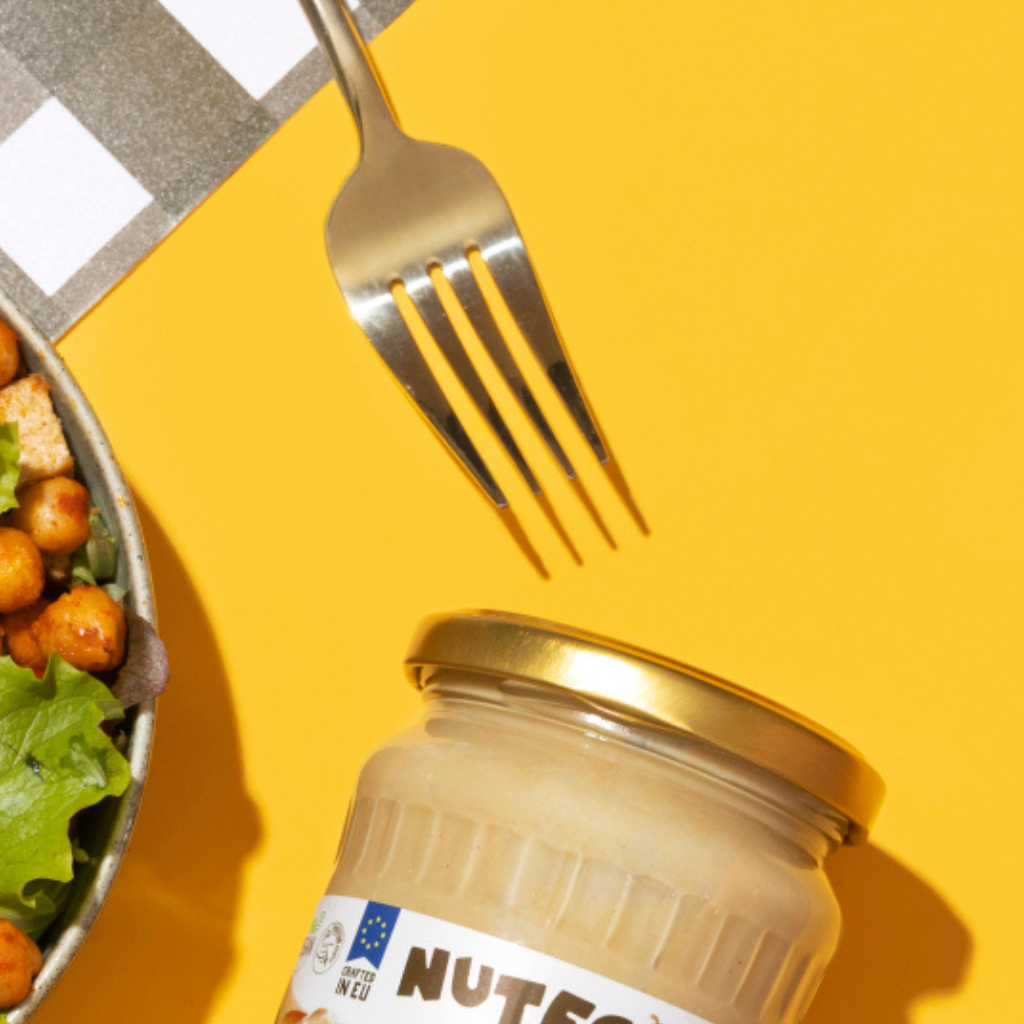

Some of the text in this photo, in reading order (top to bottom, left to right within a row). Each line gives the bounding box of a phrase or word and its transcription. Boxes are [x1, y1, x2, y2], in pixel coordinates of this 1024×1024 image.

[341, 966, 376, 983] CRAFTED
[335, 978, 371, 1001] IN EU
